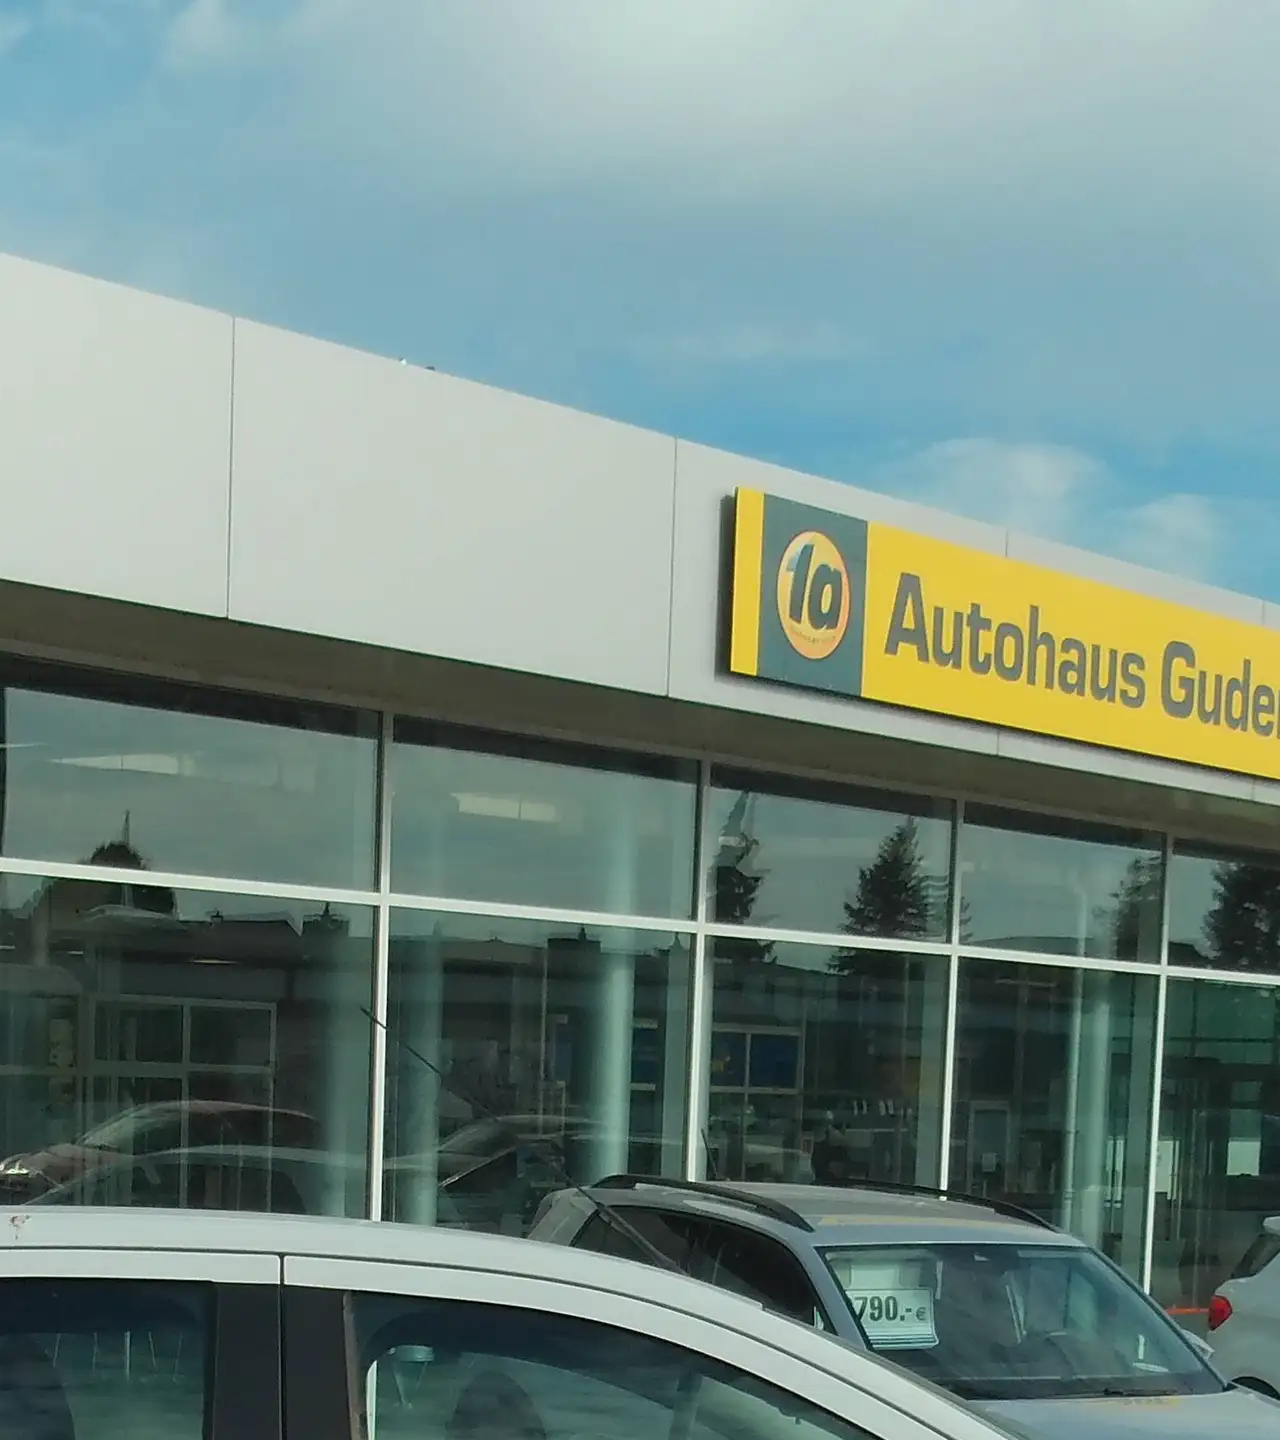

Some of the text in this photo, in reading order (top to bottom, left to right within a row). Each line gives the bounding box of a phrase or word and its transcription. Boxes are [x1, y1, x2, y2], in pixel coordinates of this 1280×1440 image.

[786, 543, 843, 630] 1a
[885, 572, 1146, 708] Autohaus
[915, 1307, 927, 1321] €
